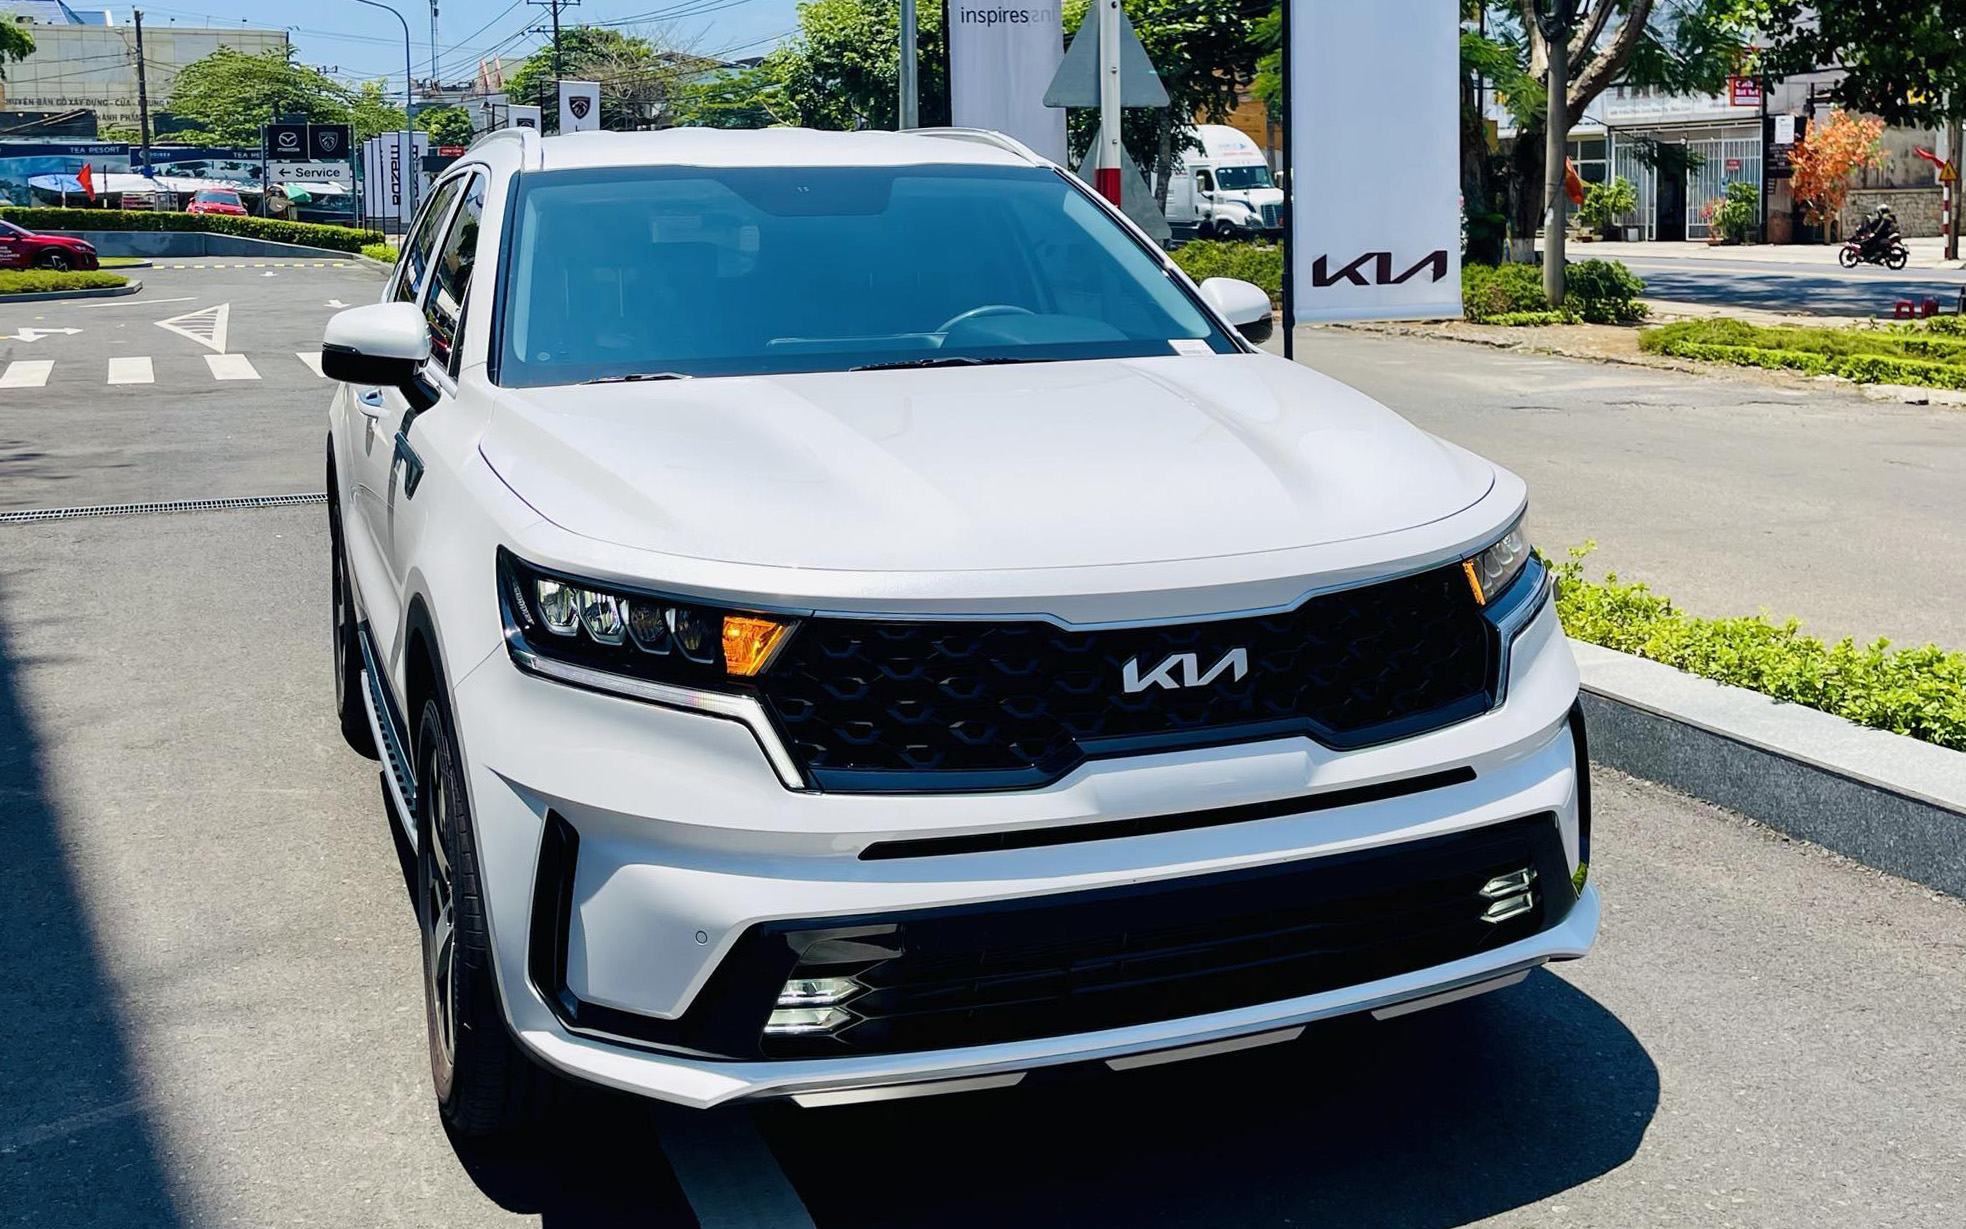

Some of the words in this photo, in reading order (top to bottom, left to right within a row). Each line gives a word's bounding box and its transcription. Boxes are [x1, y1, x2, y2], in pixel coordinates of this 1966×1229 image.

[960, 6, 1029, 27] inspires
[69, 146, 86, 154] TEA
[88, 146, 121, 154] RESORT
[295, 167, 341, 178] Service
[1312, 250, 1448, 287] KIA
[1122, 647, 1249, 693] KIA
